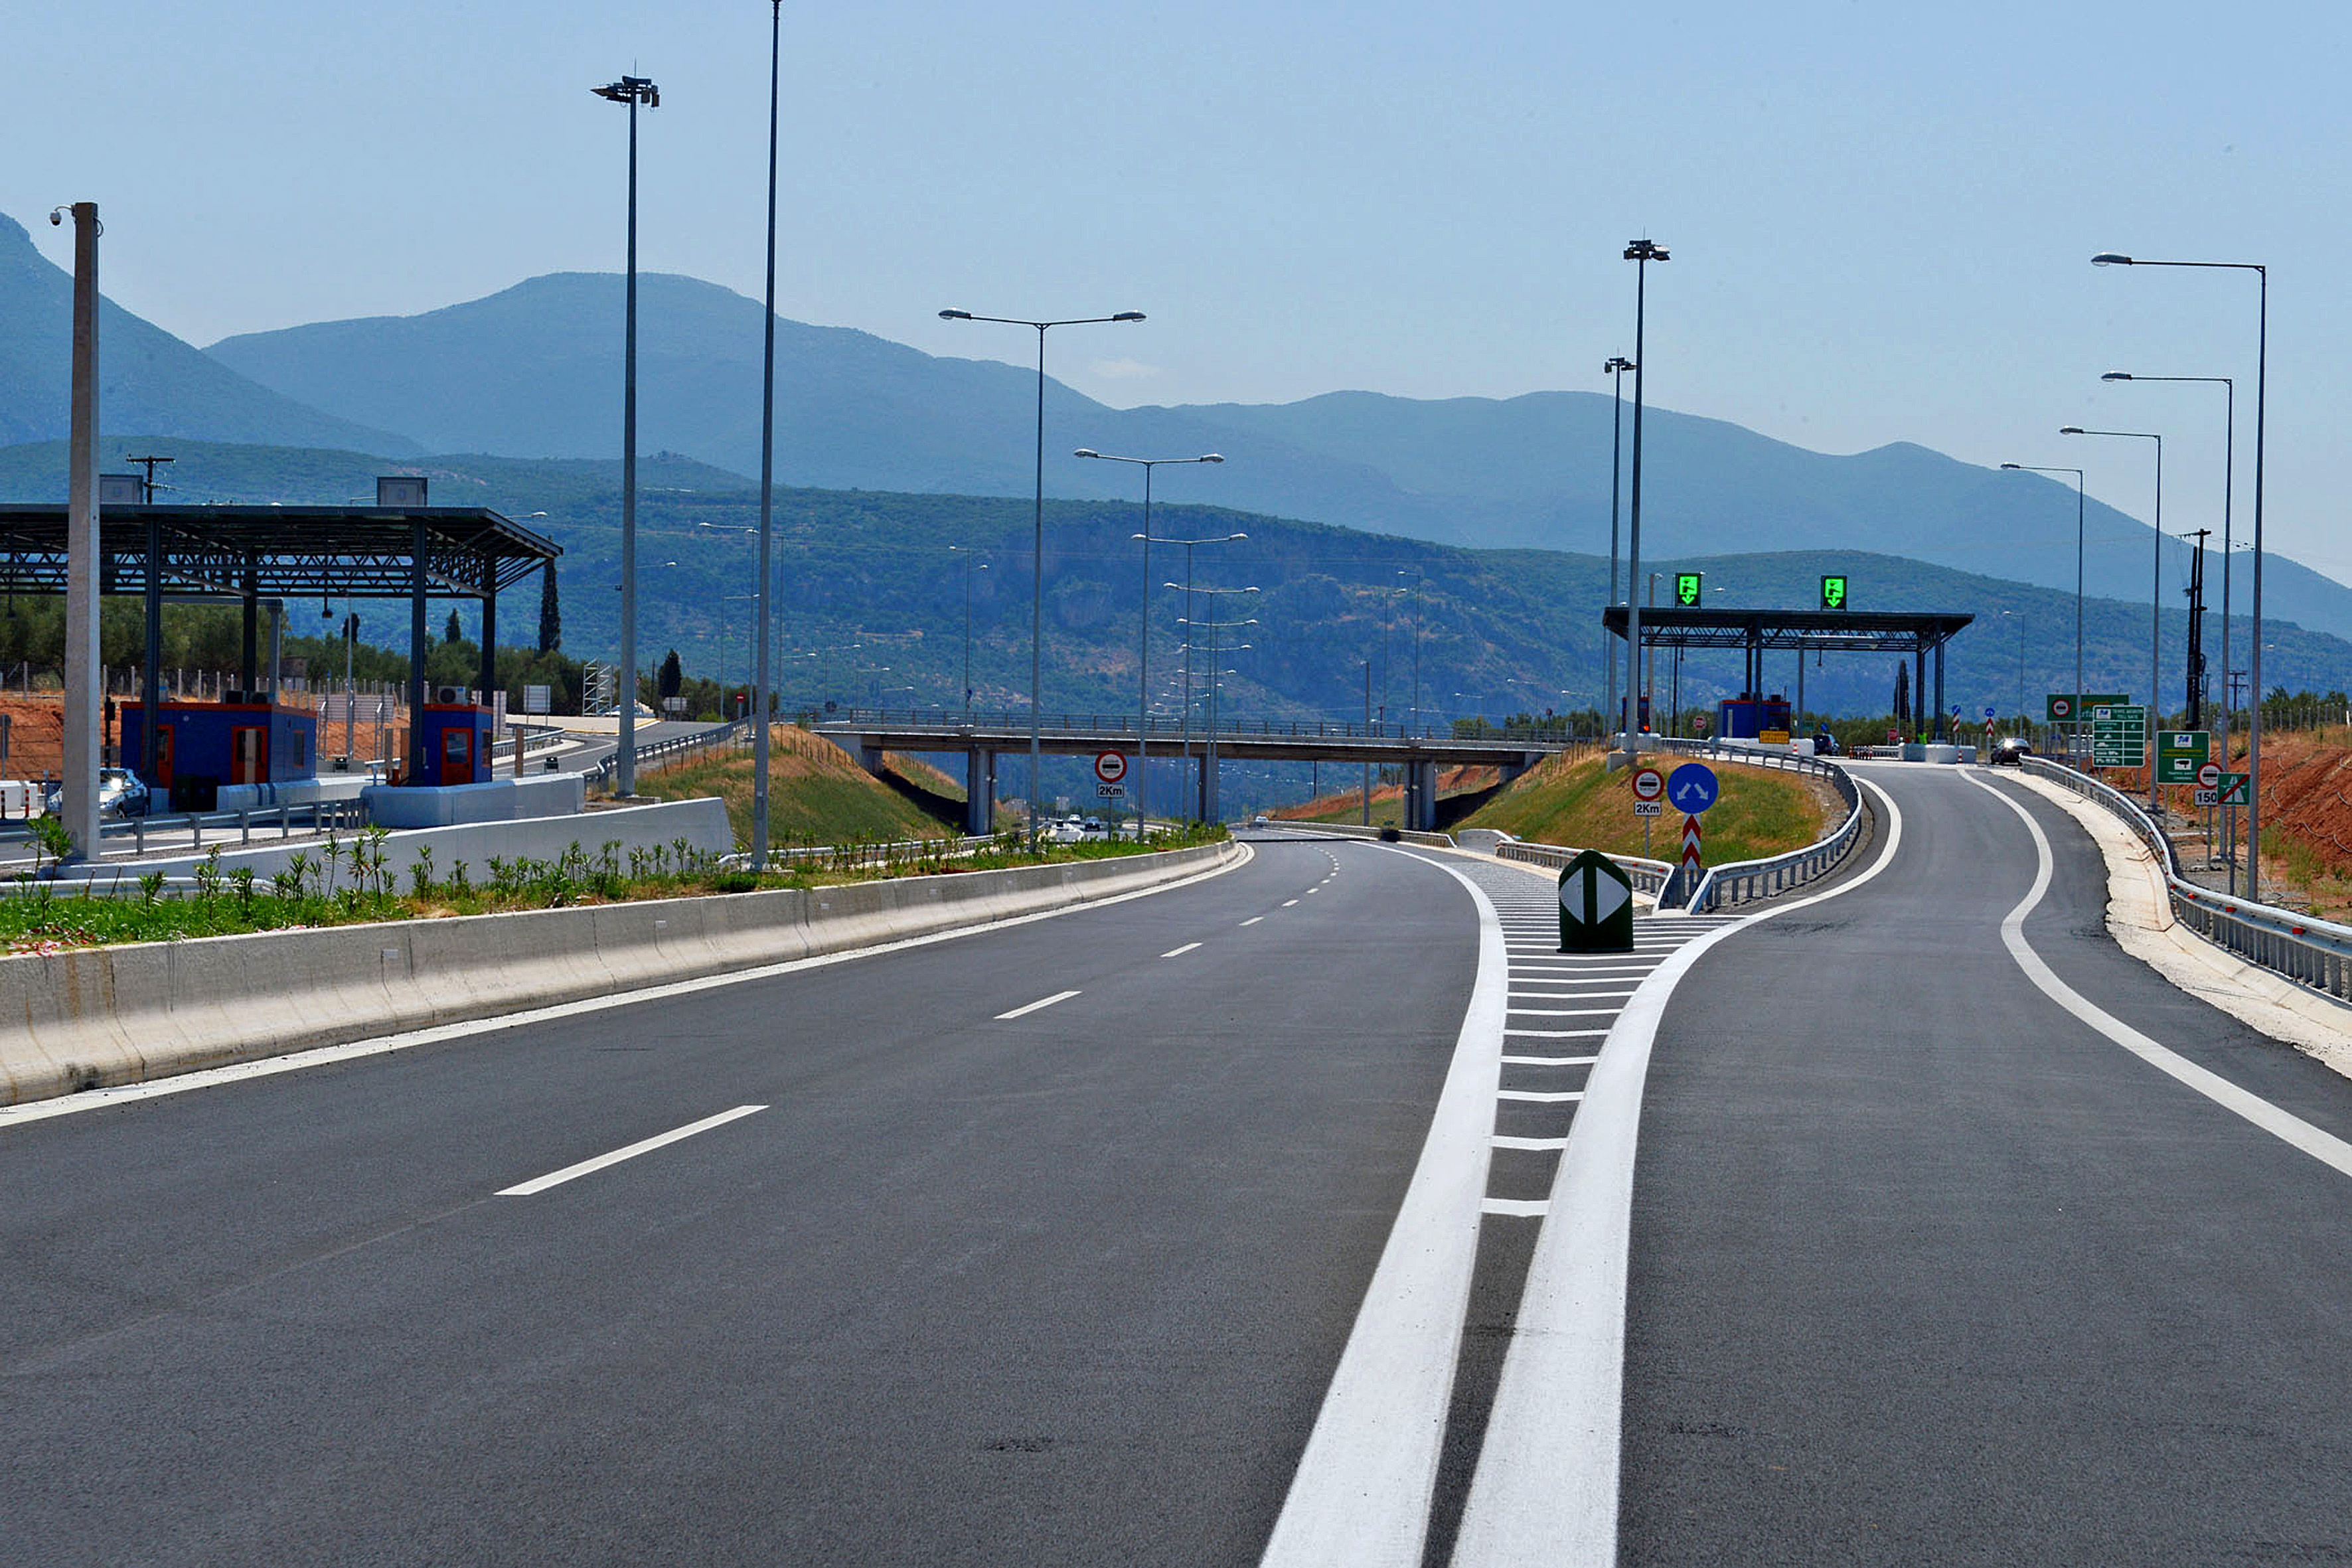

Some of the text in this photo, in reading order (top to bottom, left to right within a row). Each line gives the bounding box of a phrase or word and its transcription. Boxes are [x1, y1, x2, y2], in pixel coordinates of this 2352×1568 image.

[1099, 786, 1122, 795] 2Km
[2197, 792, 2217, 803] 150
[1636, 804, 1660, 813] 2Km
